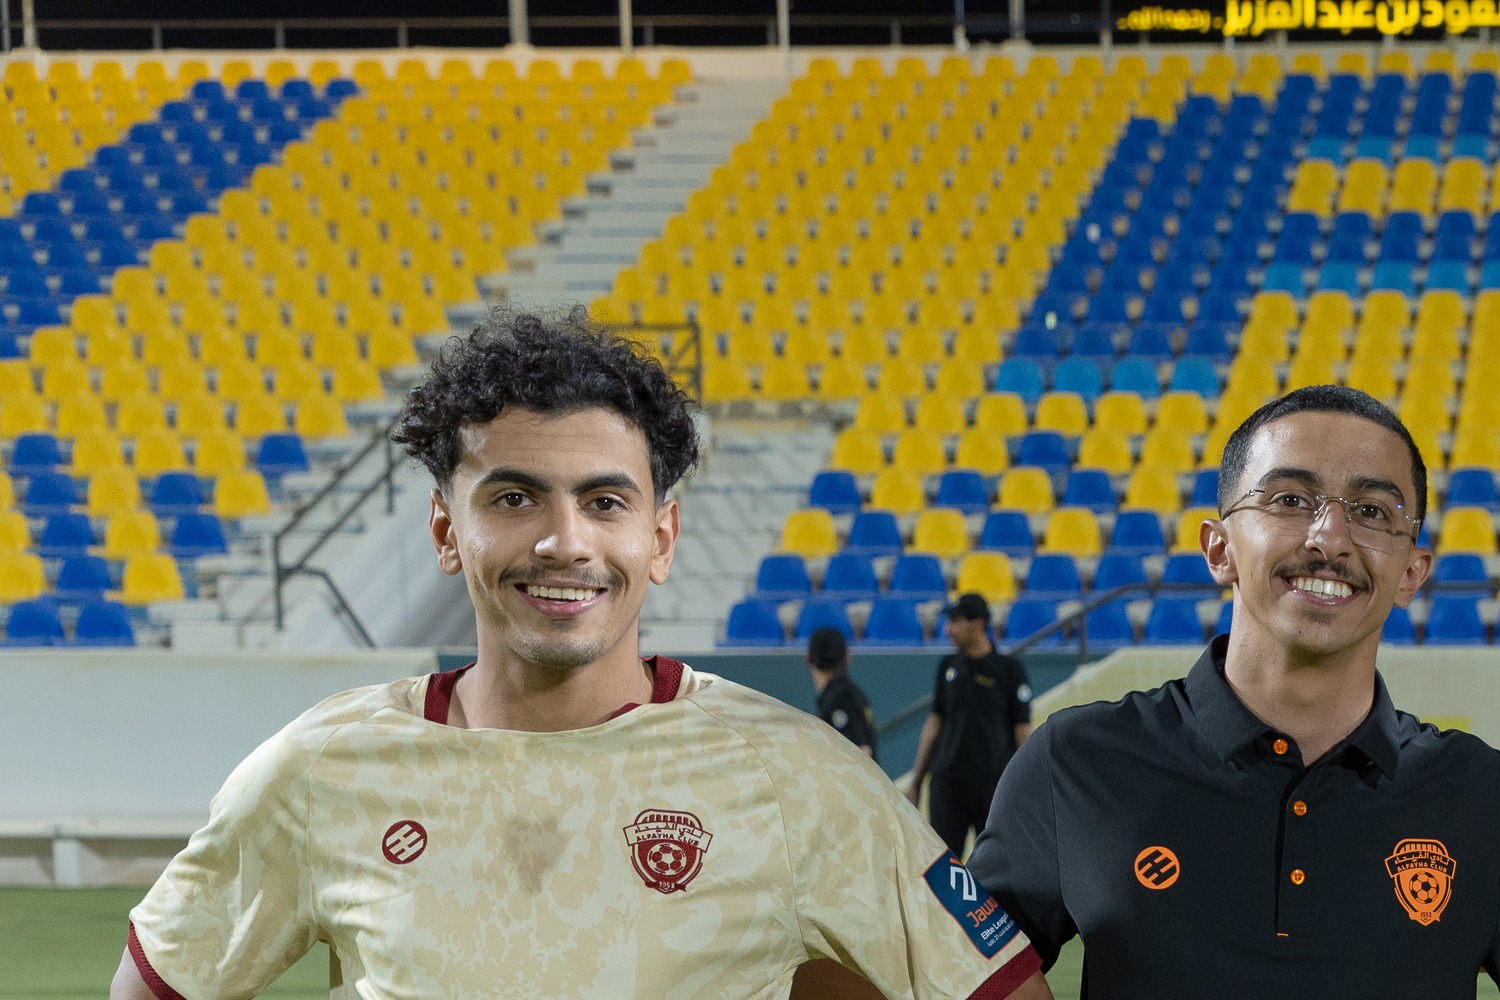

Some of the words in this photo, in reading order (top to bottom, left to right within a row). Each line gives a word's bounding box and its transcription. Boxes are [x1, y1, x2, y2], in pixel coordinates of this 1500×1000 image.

[636, 833, 675, 842] ALFAYHA
[677, 835, 699, 846] CLUB
[1397, 862, 1429, 872] ALFAYHA
[1430, 863, 1447, 873] CLUB
